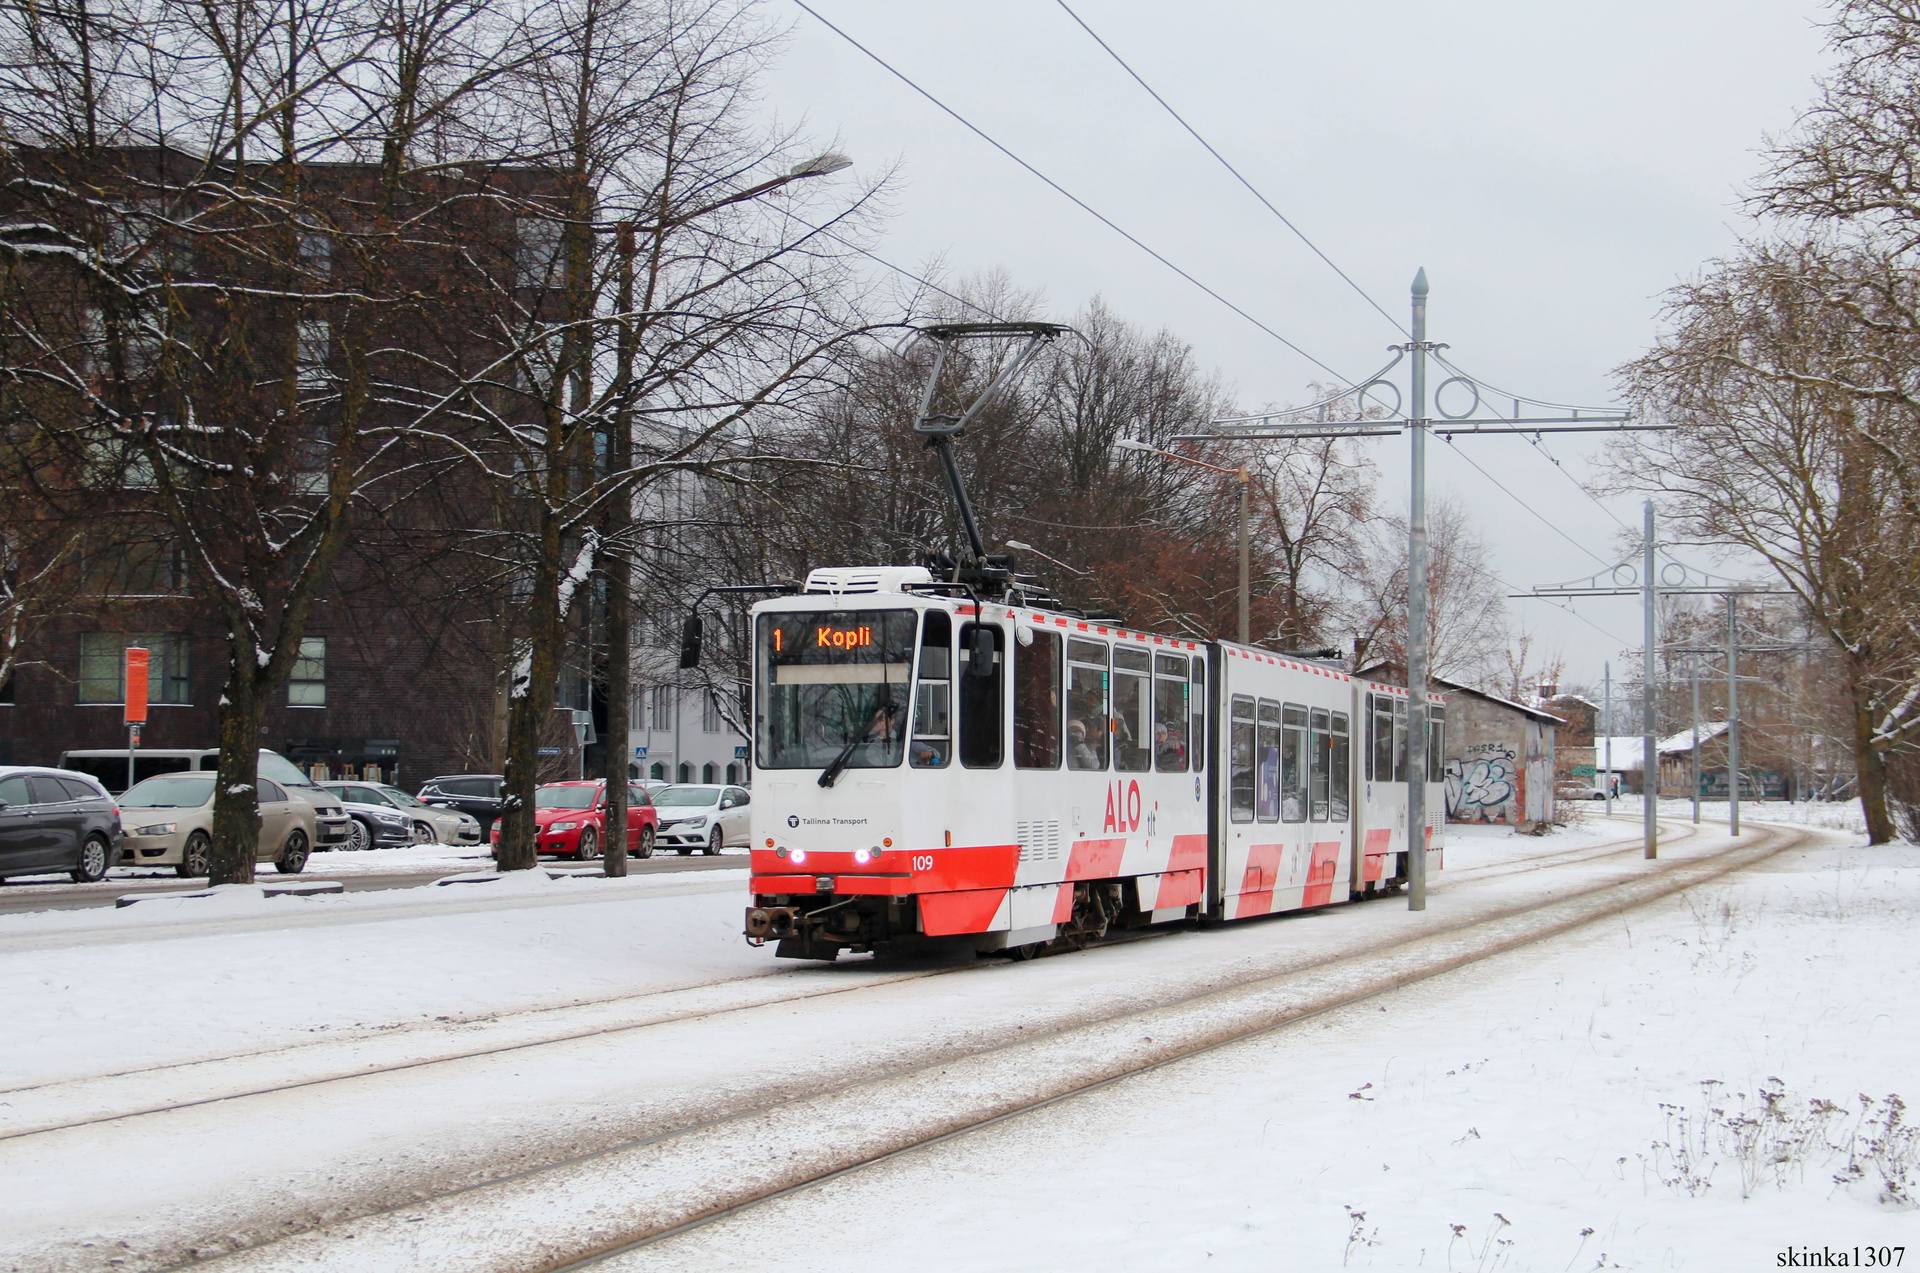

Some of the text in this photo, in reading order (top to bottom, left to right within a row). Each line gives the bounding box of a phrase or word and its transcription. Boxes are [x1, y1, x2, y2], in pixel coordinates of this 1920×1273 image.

[773, 626, 871, 652] 1 Kopli
[1103, 779, 1141, 833] ALO
[832, 818, 868, 826] Transport
[912, 855, 933, 871] 109
